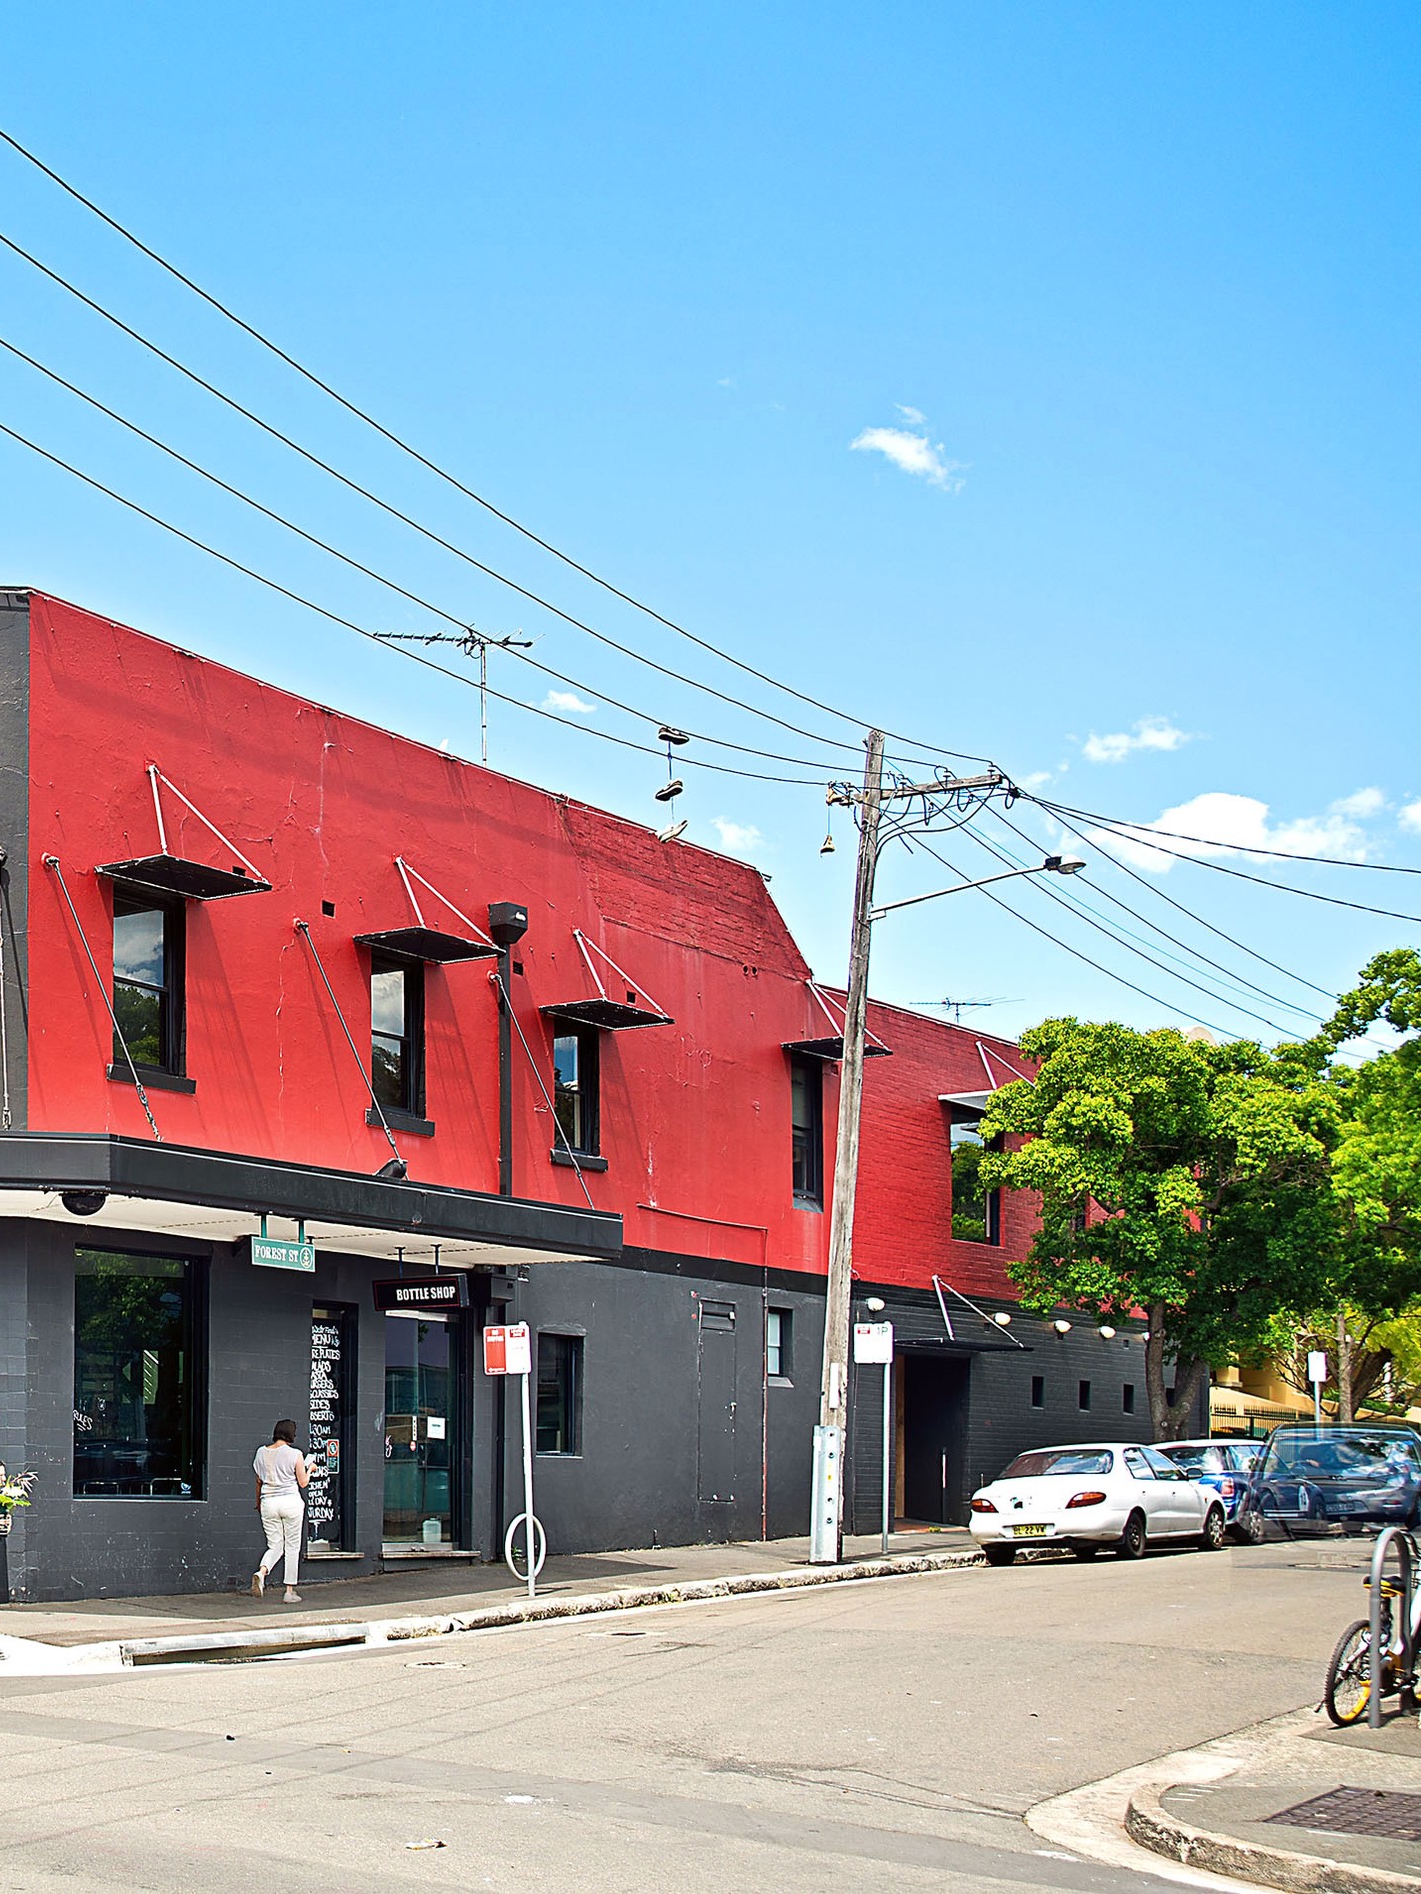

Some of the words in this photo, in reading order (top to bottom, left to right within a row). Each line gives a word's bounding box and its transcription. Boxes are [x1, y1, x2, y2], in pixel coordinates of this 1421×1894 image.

[254, 1245, 287, 1261] FOREST
[288, 1250, 299, 1263] ST
[396, 1287, 429, 1301] BOTTLE
[430, 1286, 456, 1299] SHOP
